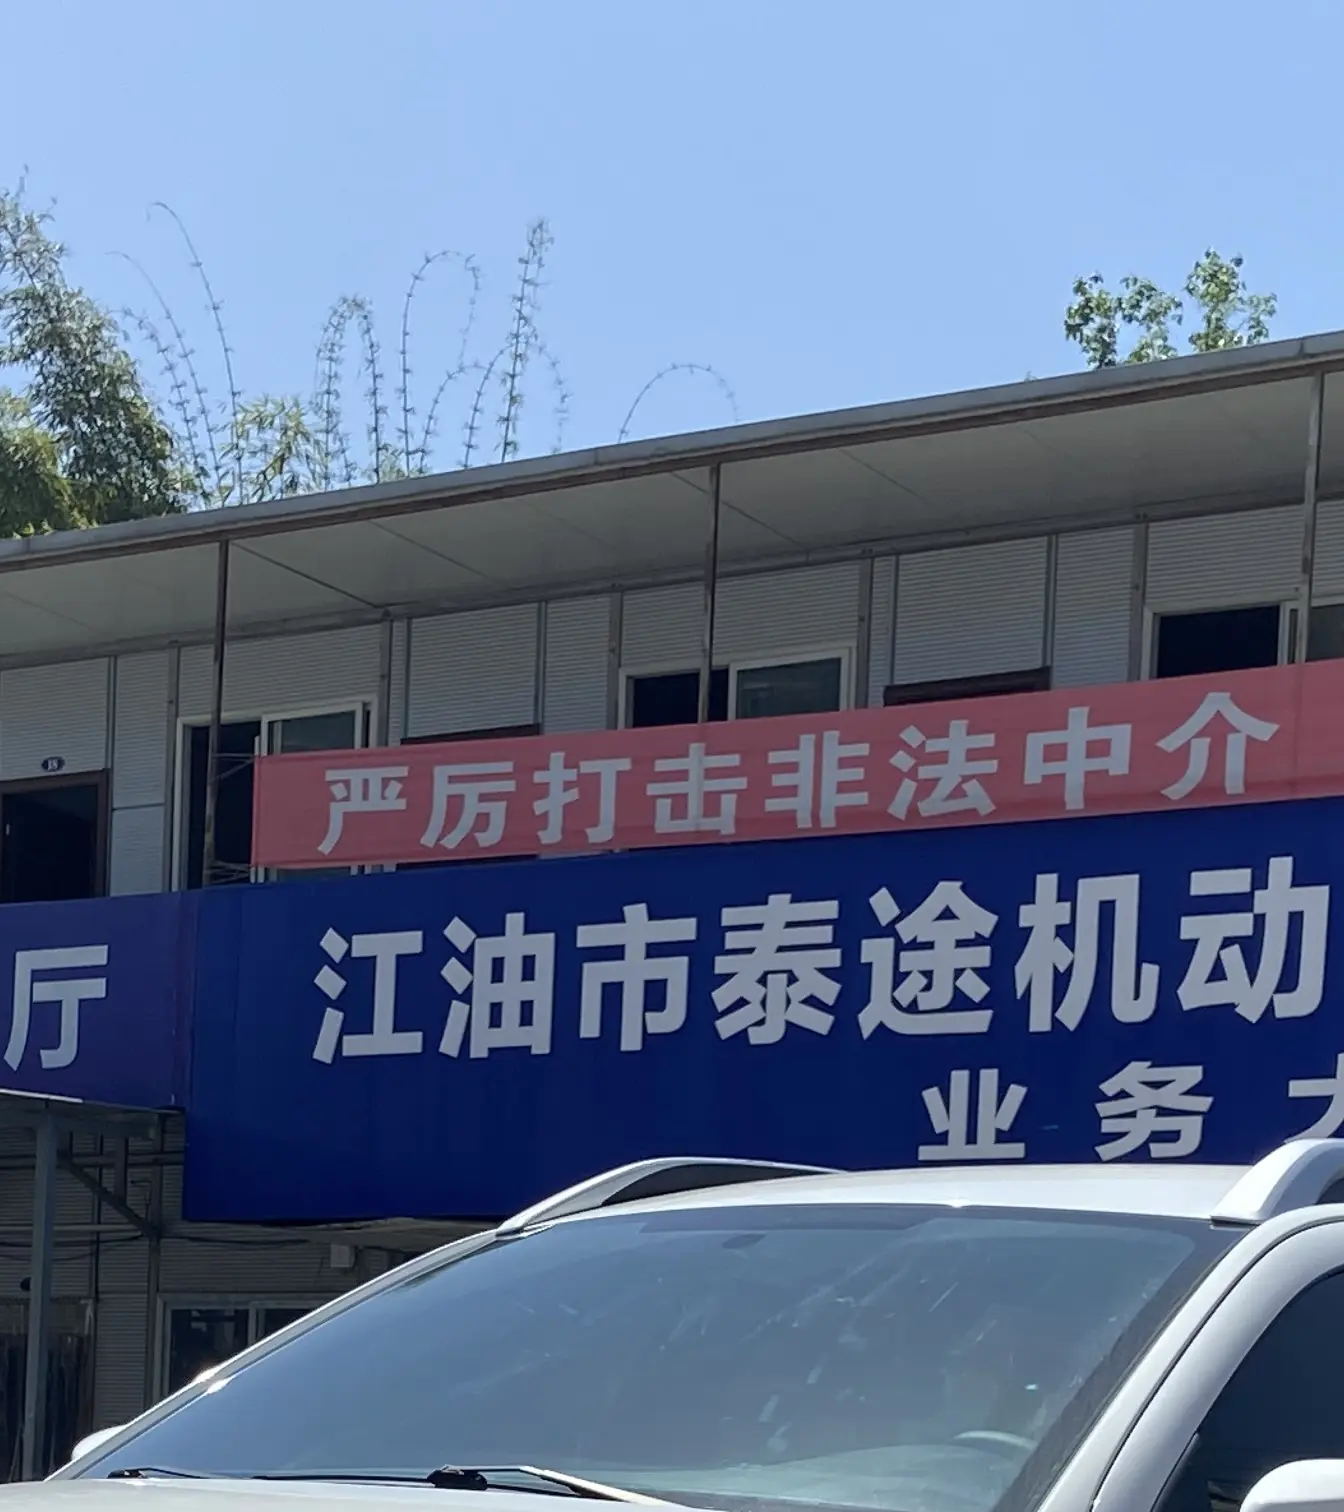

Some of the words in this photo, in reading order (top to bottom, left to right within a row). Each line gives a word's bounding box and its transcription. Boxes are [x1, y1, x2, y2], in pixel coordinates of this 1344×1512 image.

[316, 691, 1280, 855] 严厉打击非法中介
